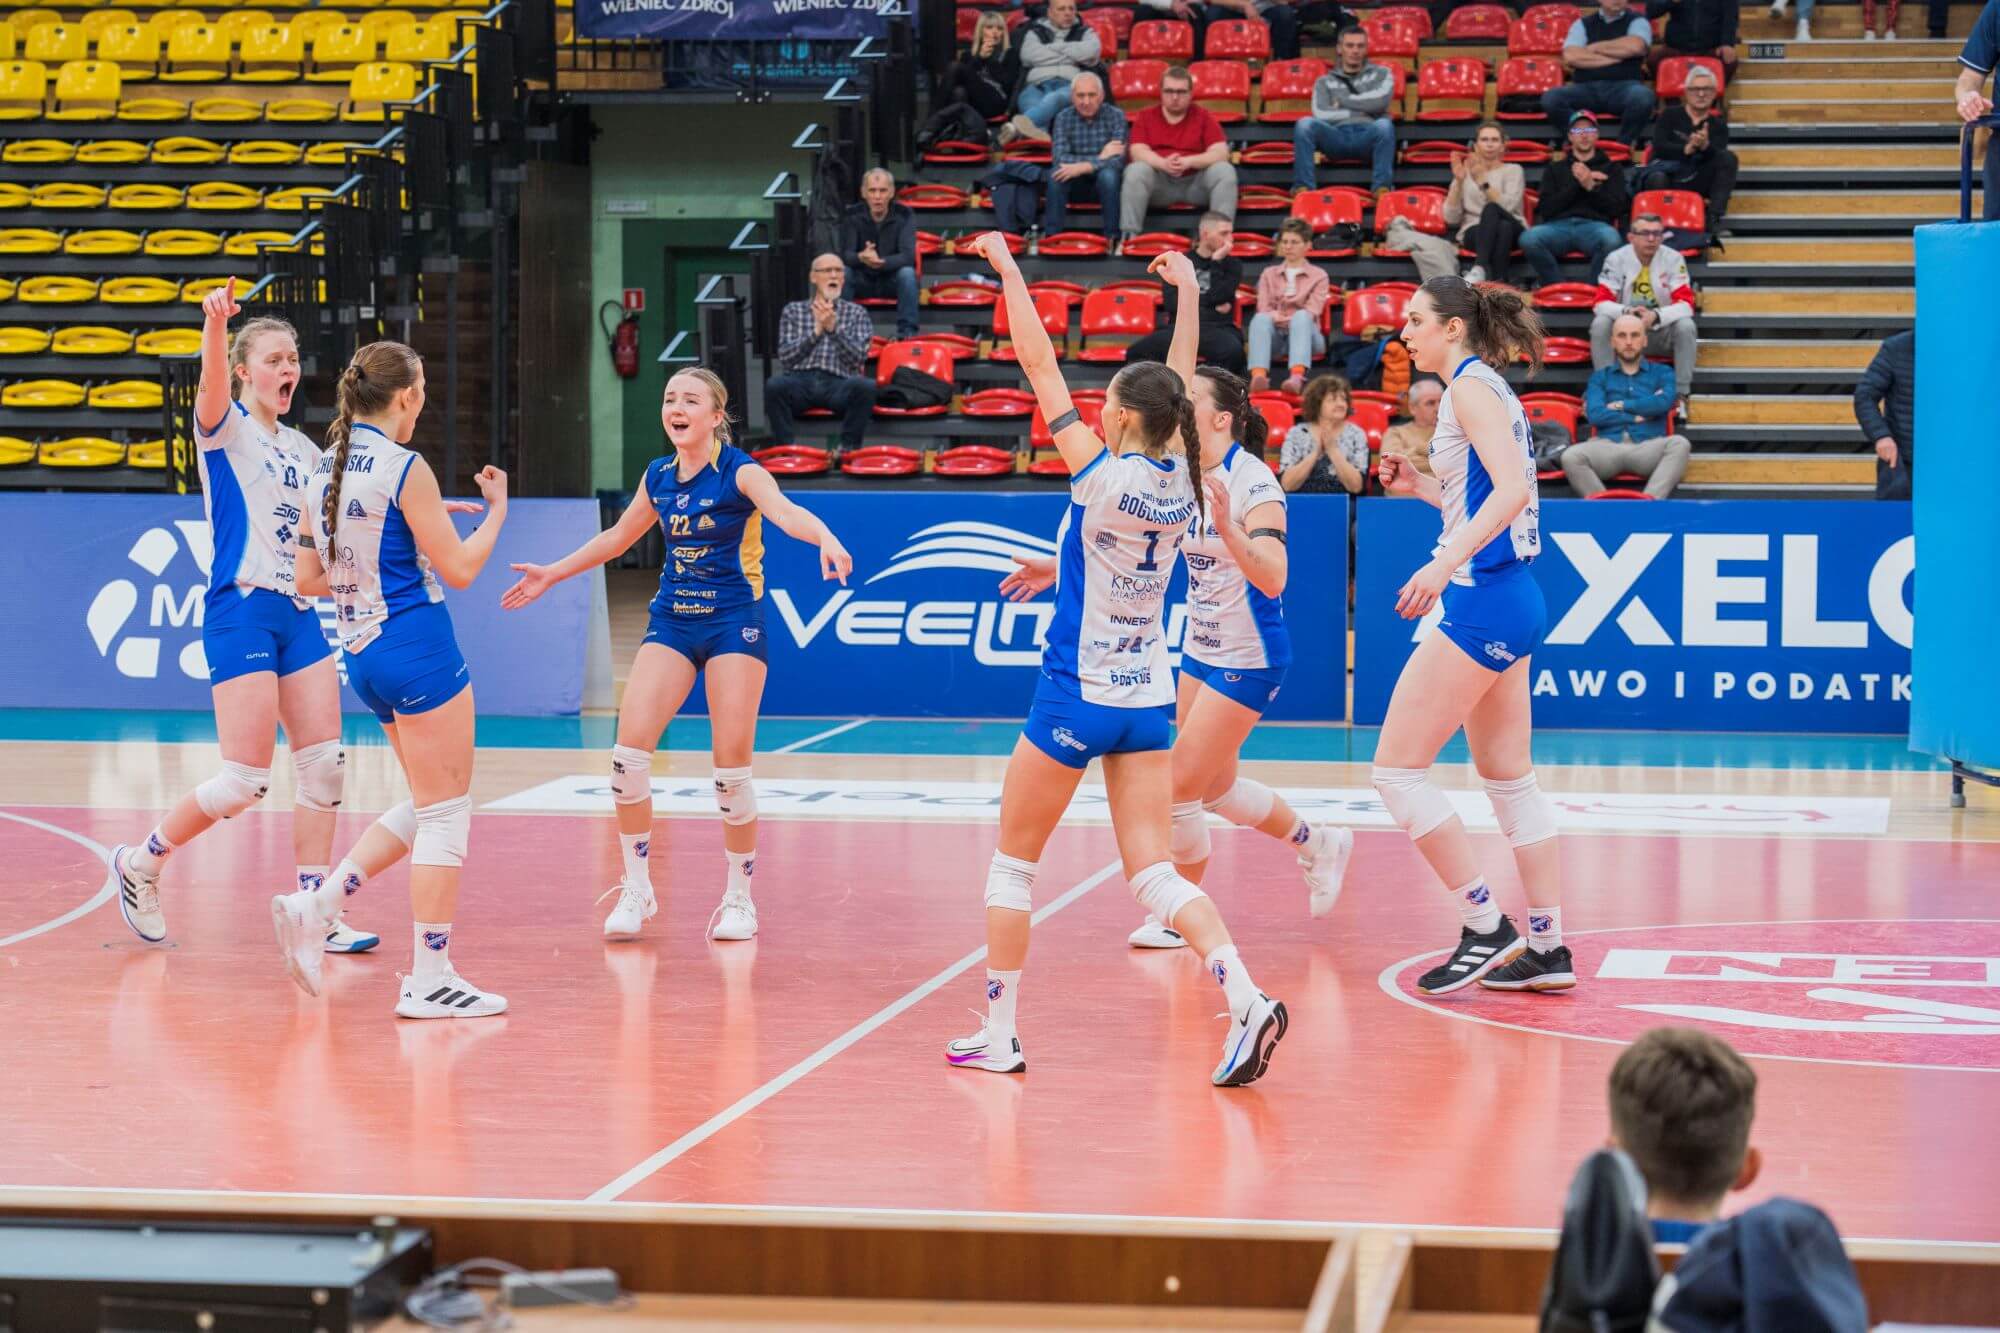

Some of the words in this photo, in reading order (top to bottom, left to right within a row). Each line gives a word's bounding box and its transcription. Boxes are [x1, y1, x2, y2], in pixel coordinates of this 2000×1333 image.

[283, 466, 299, 490] 13
[669, 514, 692, 535] 22
[1187, 515, 1198, 539] 4
[1136, 530, 1160, 571] 1
[1532, 669, 1647, 698] AWO
[1675, 671, 1685, 698] I
[1714, 671, 1912, 701] PODATK
